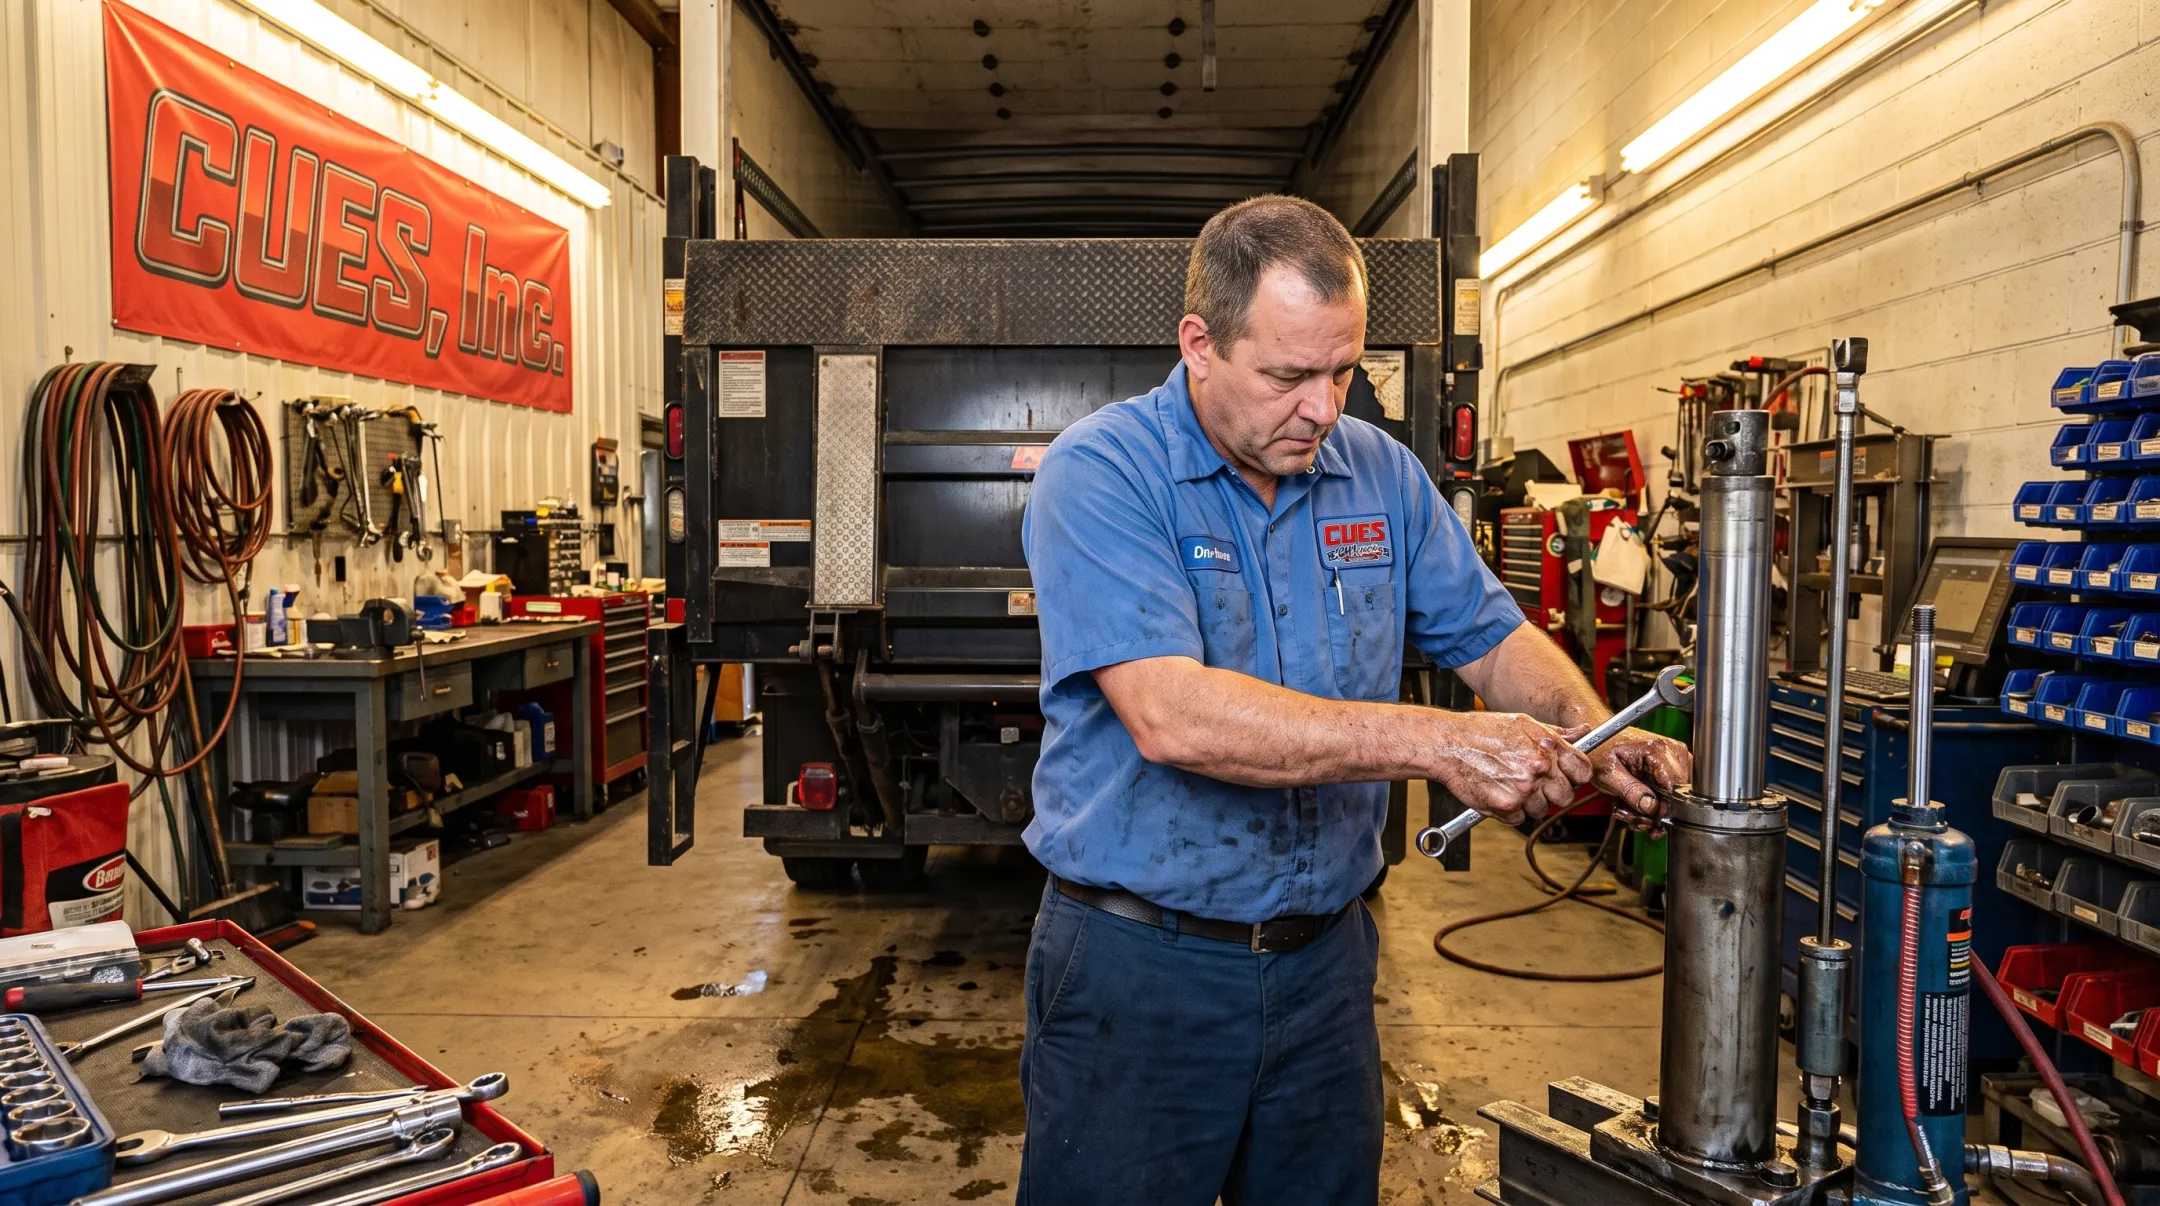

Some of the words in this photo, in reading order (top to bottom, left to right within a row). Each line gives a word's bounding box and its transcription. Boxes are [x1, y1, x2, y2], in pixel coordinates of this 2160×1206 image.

[134, 87, 448, 358] CUES,
[458, 223, 565, 376] Inc.
[1324, 521, 1386, 546] CUES
